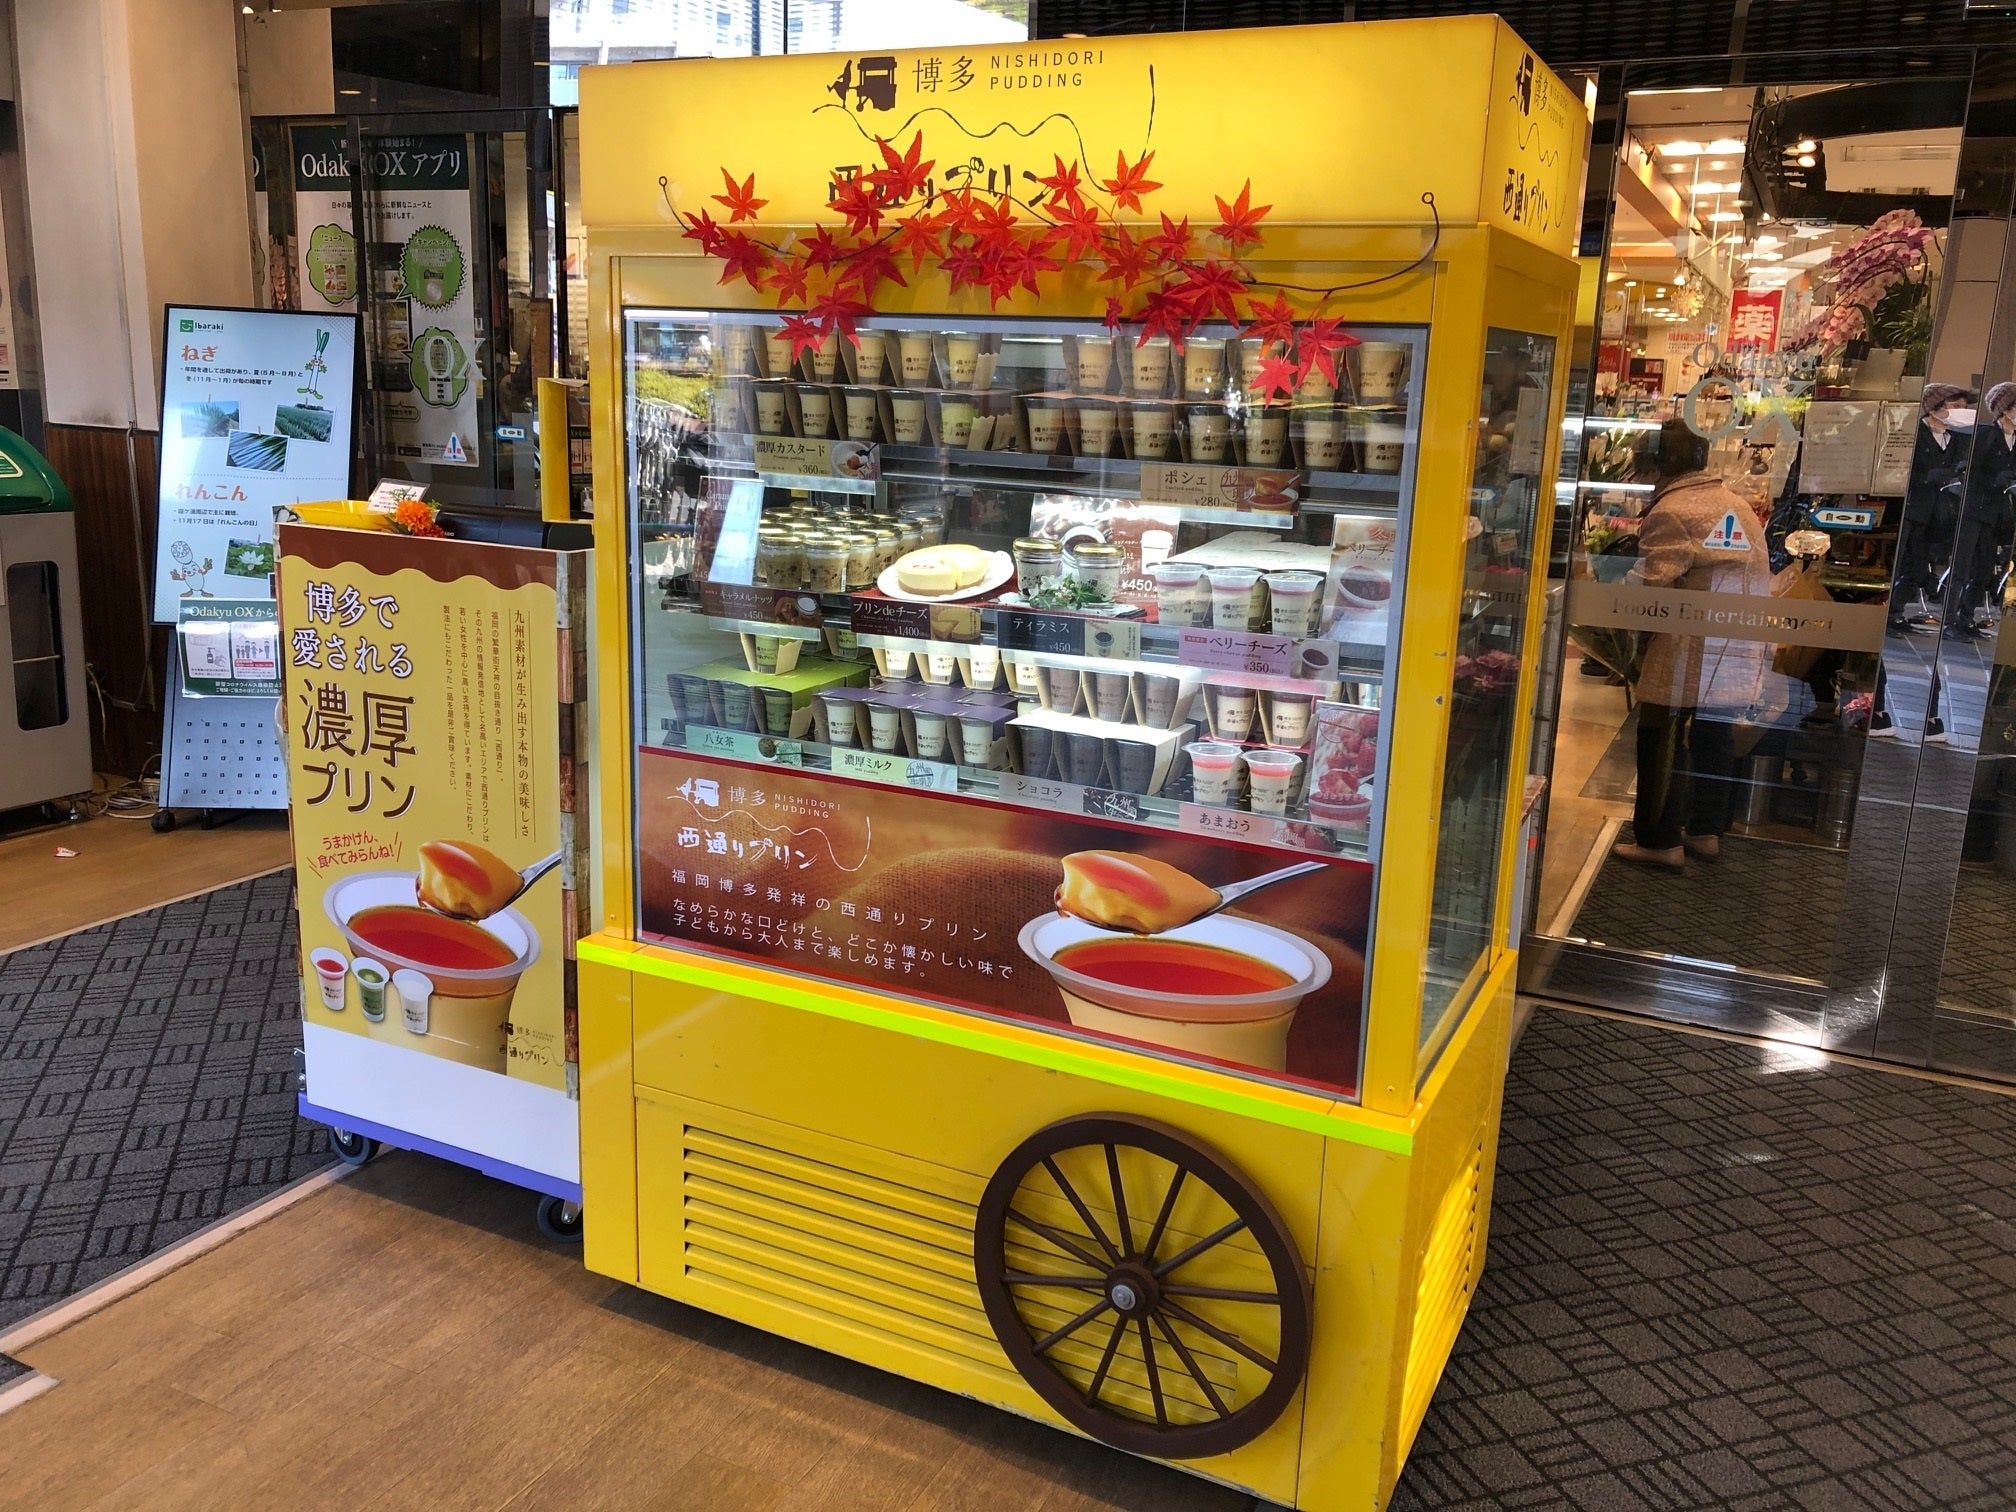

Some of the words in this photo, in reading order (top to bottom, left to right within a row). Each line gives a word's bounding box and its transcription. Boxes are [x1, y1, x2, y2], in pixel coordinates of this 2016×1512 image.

[991, 50, 1104, 70] NISHIDORI
[912, 57, 976, 94] 博多
[990, 73, 1084, 90] PUDDING
[411, 150, 461, 177] アプリ
[1503, 167, 1548, 235] 西通りプリン
[194, 322, 224, 332] Ibaraki
[1734, 304, 1775, 341] 薬
[181, 345, 219, 362] ねぎ
[756, 440, 825, 457] 濃厚カスタード
[798, 464, 819, 475] ¥360
[1165, 470, 1208, 486] ポシェ
[175, 484, 248, 502] れんこん
[1195, 496, 1220, 507] ¥280
[1121, 578, 1153, 592] ¥450
[189, 606, 233, 617] Odakyu
[234, 607, 255, 617] OX
[304, 580, 400, 630] 博多で
[853, 601, 928, 619] プリンdeチーズ
[1611, 597, 1670, 618] Foods
[1679, 602, 1834, 633] Entertainment
[894, 626, 920, 637] ¥1,400
[1013, 617, 1070, 634] ティラミス
[291, 627, 415, 679] 愛される
[1049, 642, 1071, 653] ¥450
[1209, 636, 1288, 656] ベリーチーズ
[1244, 661, 1269, 673] ¥350
[299, 678, 418, 768] 濃厚
[514, 608, 530, 838] 九州素材が生み出す本物の美味しさ
[704, 734, 735, 748] 八女茶
[844, 753, 892, 771] 濃厚ミルク
[302, 761, 418, 819] プリン
[727, 785, 767, 807] 博多
[1017, 780, 1063, 799] ショコラ
[774, 792, 842, 811] NISHIDORI
[774, 802, 830, 819] PUDDING
[1199, 812, 1250, 832] あまおう
[322, 830, 378, 850] うまかけん、
[677, 826, 819, 871] 西通りプリン
[671, 868, 988, 942] 福岡博多発祥の西通りプリン
[672, 897, 1015, 981] なめらかな口どけと、どこか懐かしい味で
[672, 912, 927, 979] 子どもから大人まで楽しめます。
